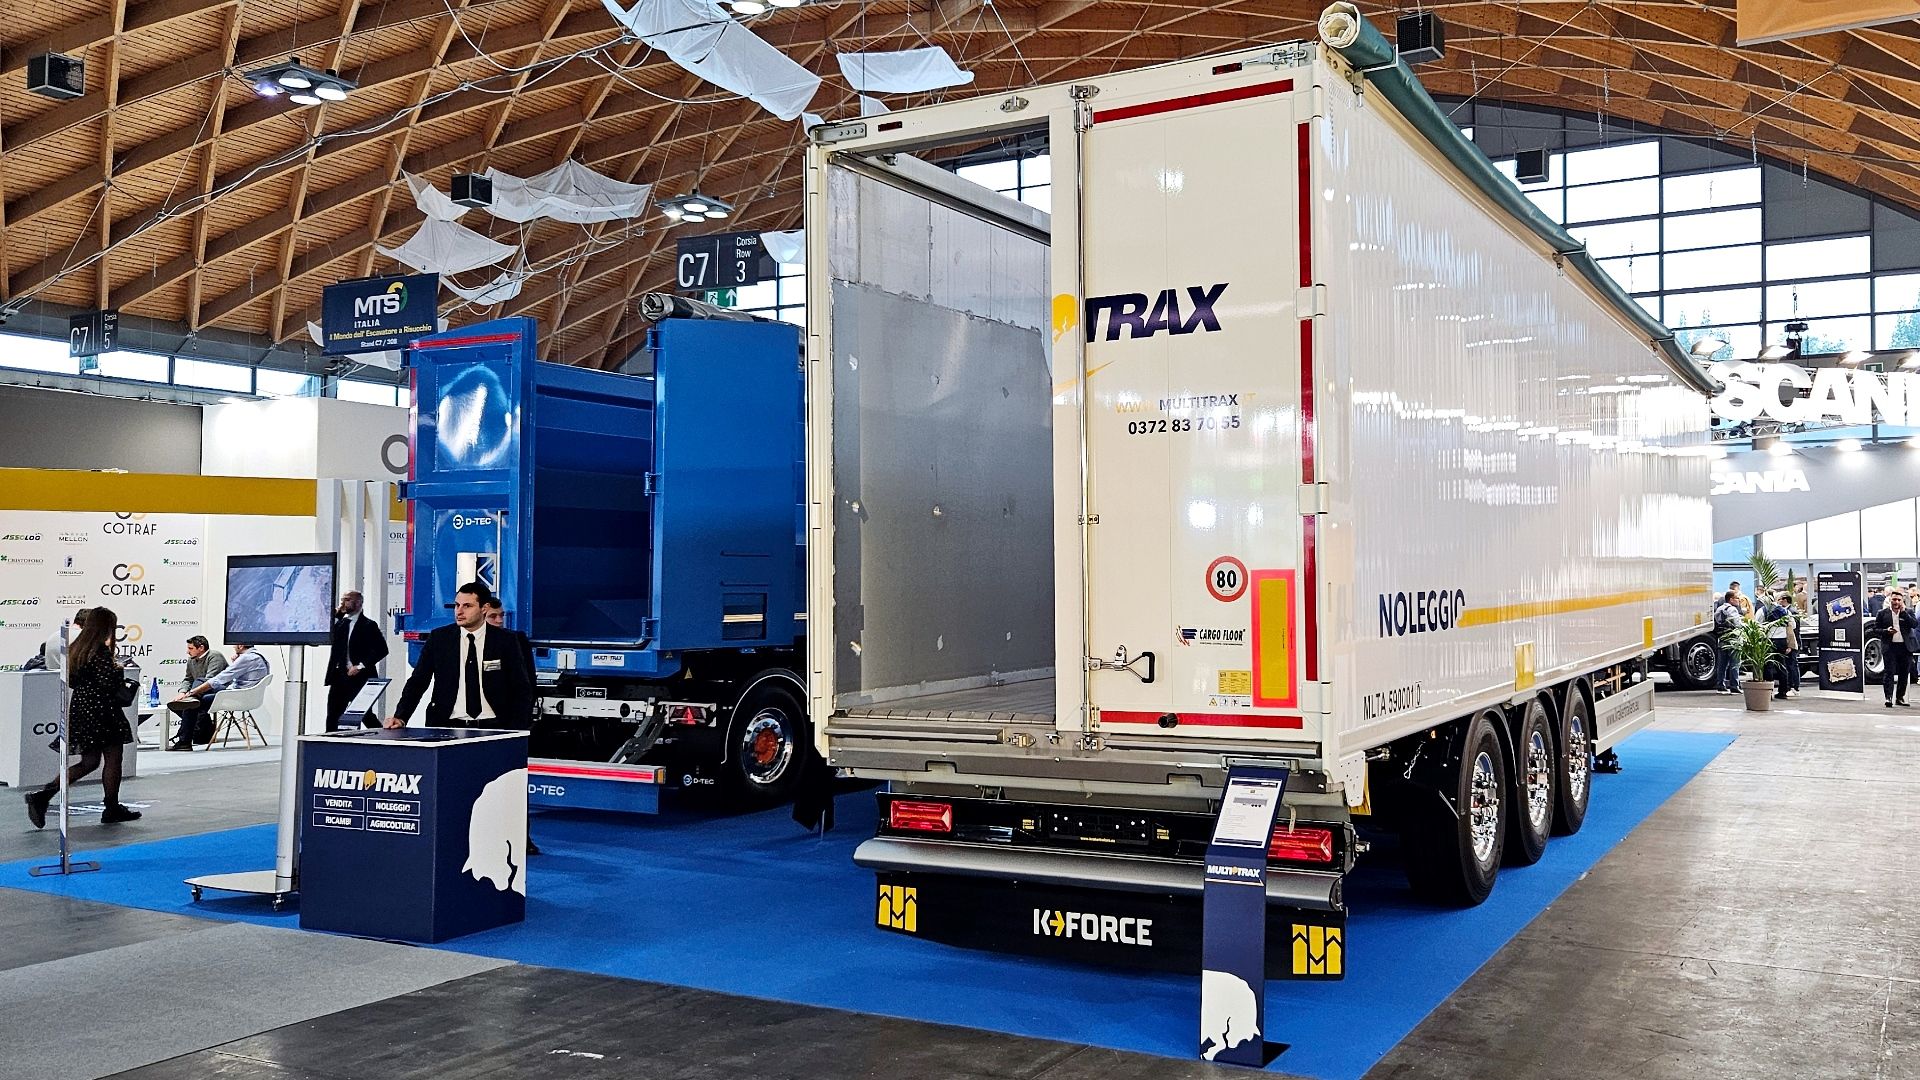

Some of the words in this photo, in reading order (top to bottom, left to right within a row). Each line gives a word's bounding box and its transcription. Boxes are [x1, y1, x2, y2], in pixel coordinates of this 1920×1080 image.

[736, 236, 757, 246] Corsia
[736, 249, 751, 258] Row
[679, 253, 709, 287] C7
[736, 261, 746, 282] 3
[354, 293, 400, 318] MTS
[1086, 283, 1230, 343] TRAX
[354, 319, 380, 328] ITALIA
[71, 326, 88, 353] C7
[104, 333, 110, 349] 5
[1128, 420, 1167, 435] 0372
[1171, 419, 1191, 432] 83
[1196, 417, 1216, 431] 70
[1221, 415, 1241, 430] 55
[1710, 470, 1811, 495] CANIA
[465, 517, 492, 526] D-TEC
[103, 522, 157, 535] COTRAF
[1216, 570, 1237, 588] 80
[100, 584, 155, 596] COTRAF
[1199, 629, 1221, 640] CARGO
[1222, 629, 1243, 641] FLOOR
[113, 645, 153, 657] TRAF
[1363, 692, 1387, 720] MLTA
[528, 784, 565, 796] D-TEC
[325, 799, 353, 808] VENDITA
[375, 802, 411, 812] NOLEGGIO
[325, 816, 352, 825] RICAMBI
[370, 820, 416, 831] AGRICOLTURA
